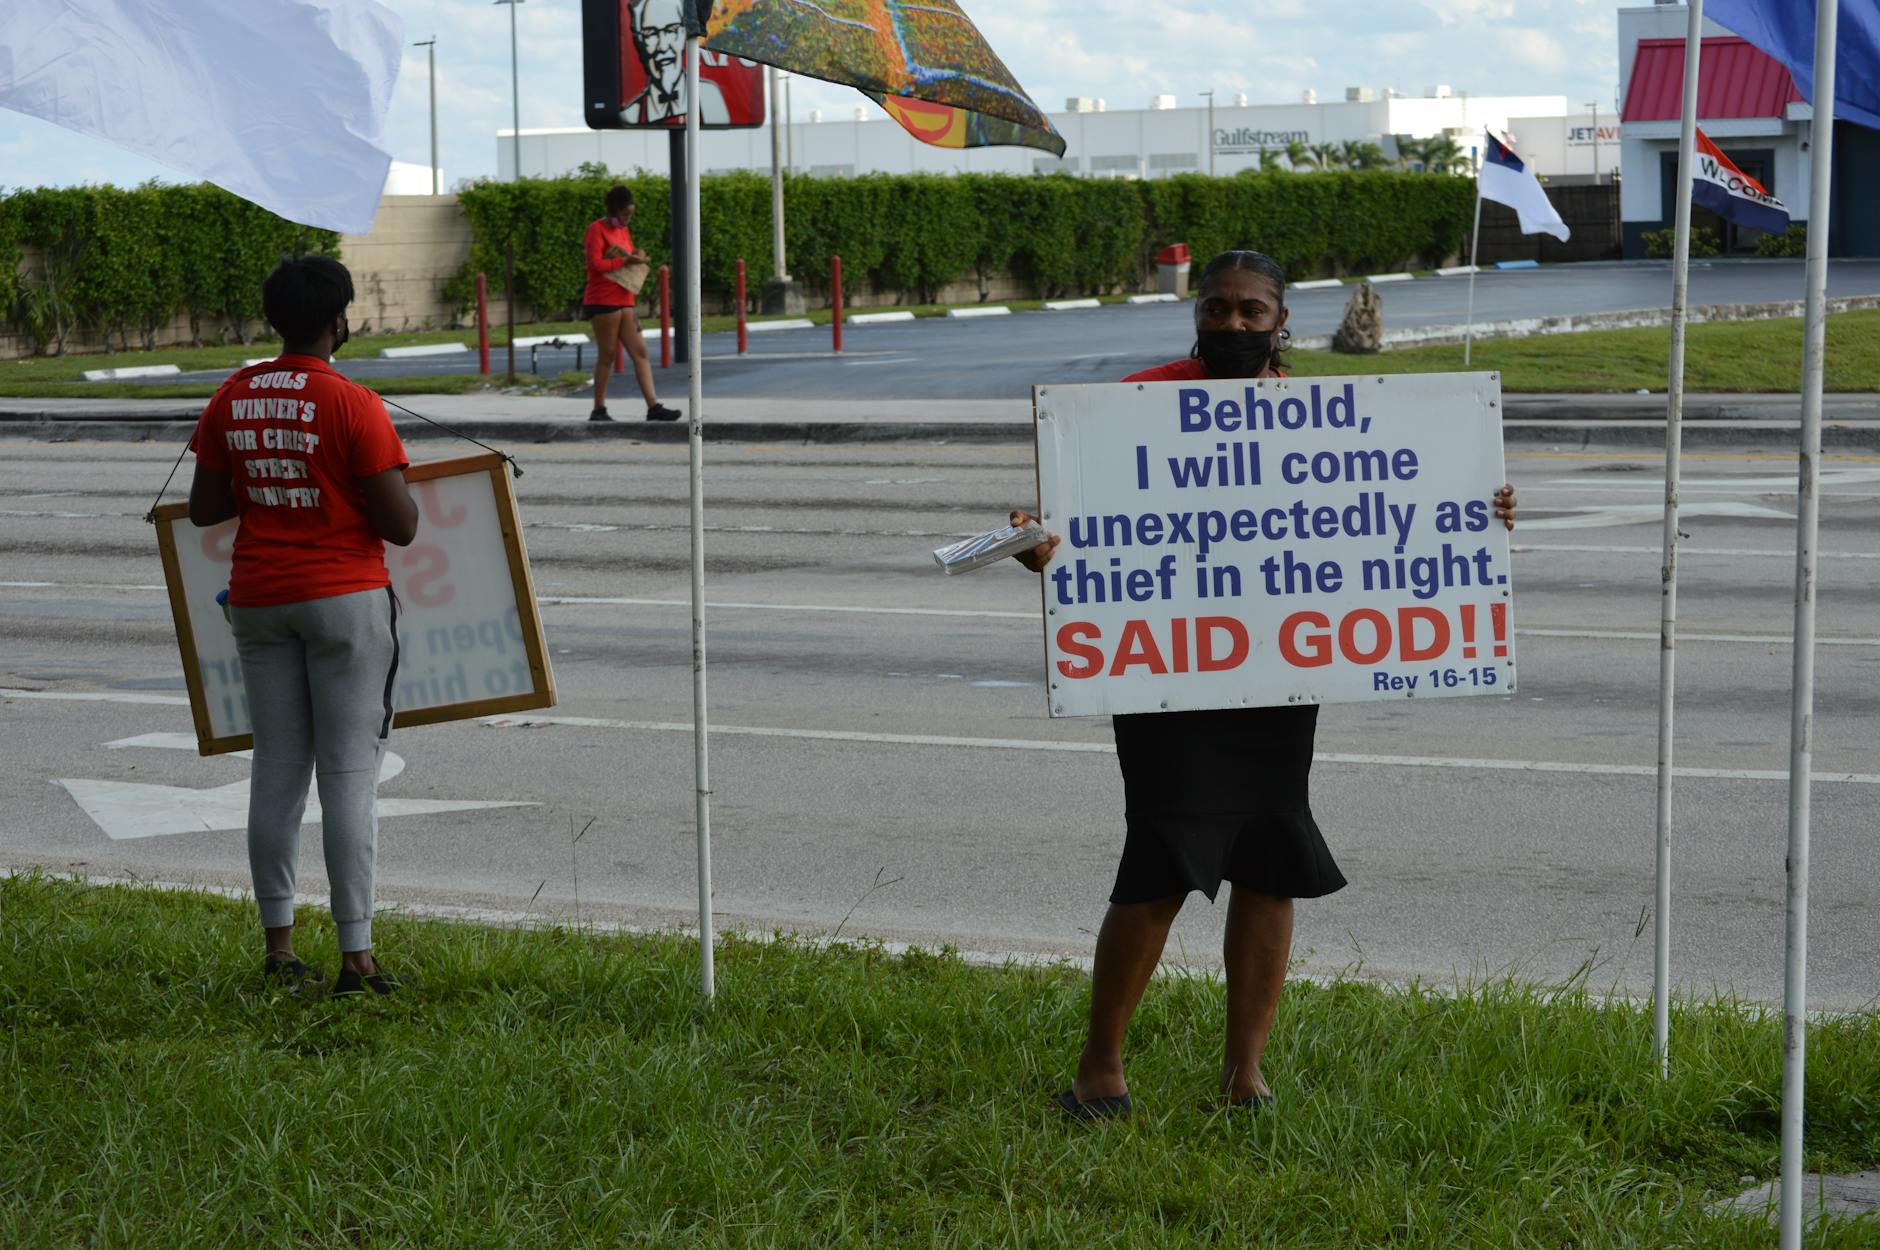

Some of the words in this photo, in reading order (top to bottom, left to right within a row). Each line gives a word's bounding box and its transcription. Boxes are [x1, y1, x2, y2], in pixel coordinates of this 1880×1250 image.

[1215, 127, 1309, 146] Gulfstream
[249, 371, 308, 390] SOULS
[231, 398, 316, 422] WINNER'S
[1179, 384, 1372, 434] Behold,
[225, 430, 258, 450] FOR
[1136, 446, 1149, 489] I
[1168, 442, 1262, 488] will
[1281, 447, 1419, 486] come
[1069, 492, 1417, 554] unexpectedly
[1435, 500, 1489, 533] as
[1051, 555, 1177, 605] thief
[1196, 554, 1242, 598] in
[1260, 550, 1343, 596] the
[1362, 544, 1507, 599] night.
[1056, 616, 1250, 679] SAID
[1278, 603, 1508, 668] GOD!!
[1373, 671, 1419, 691] Rev
[1429, 667, 1497, 688] 16-15
